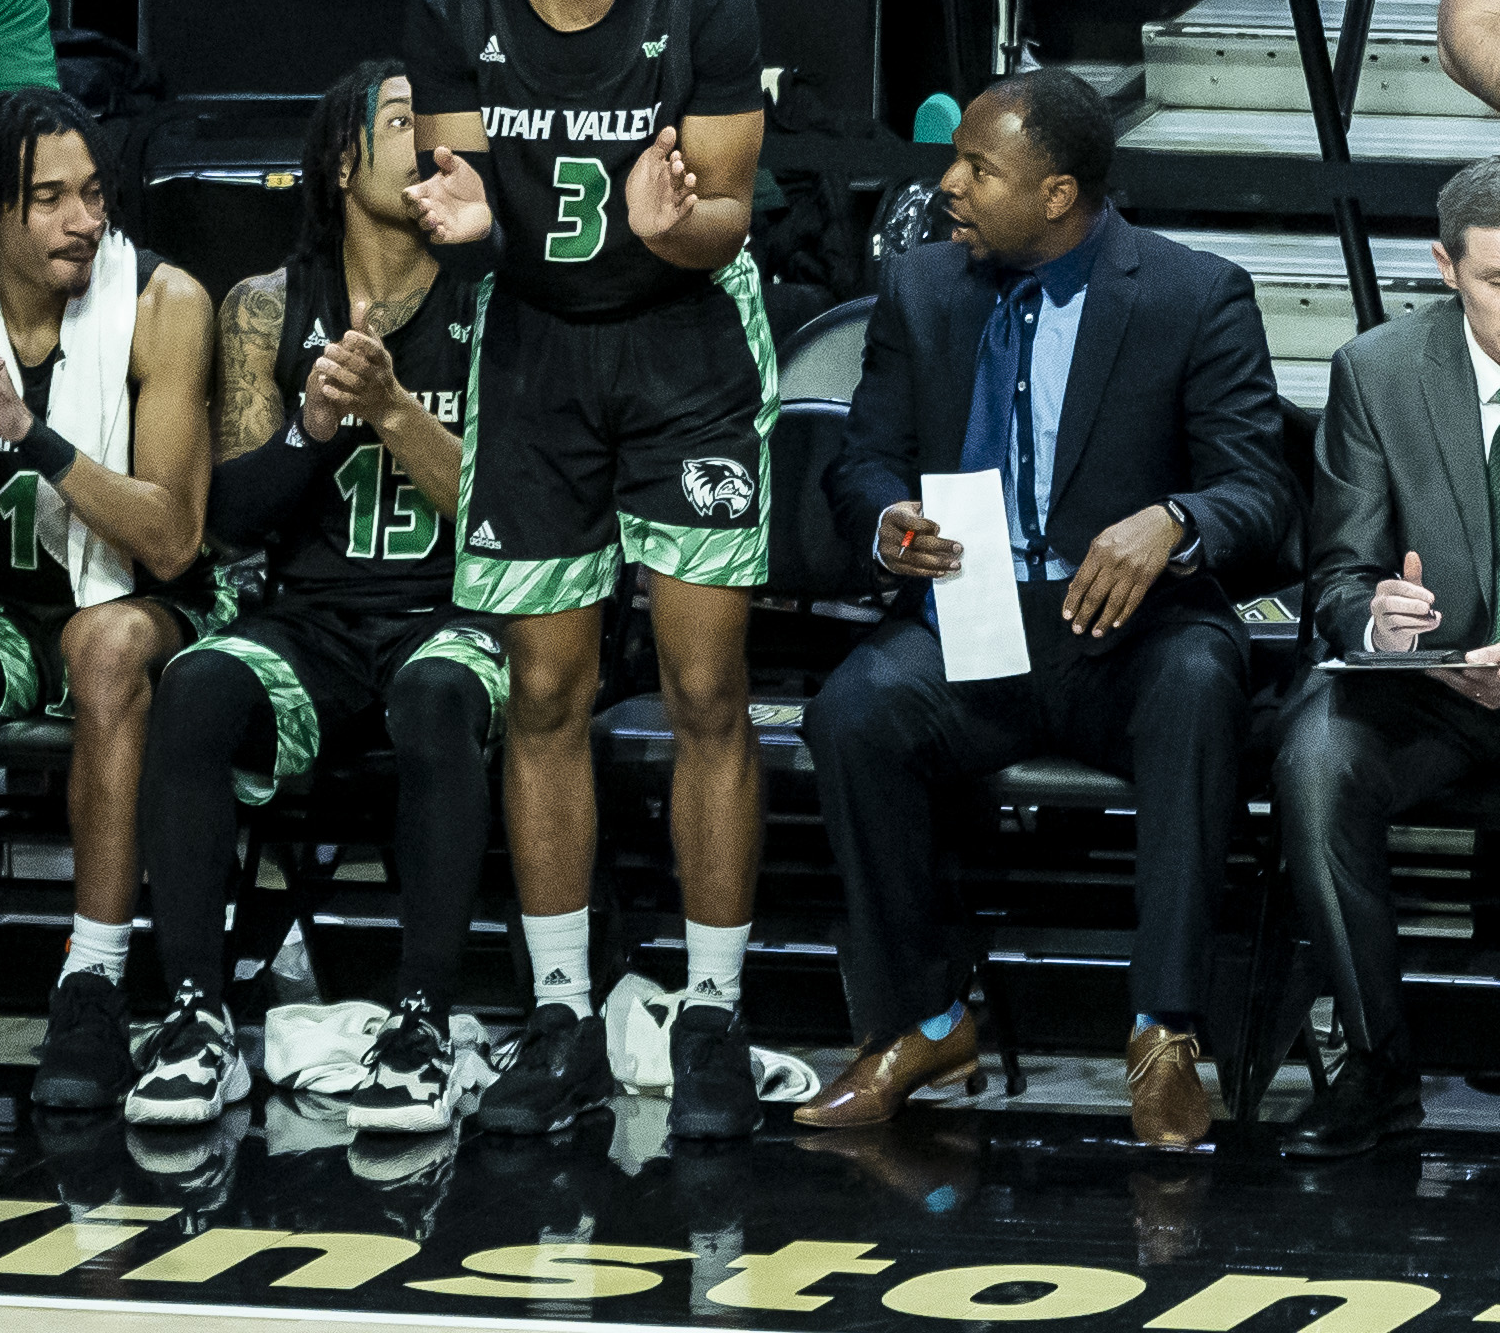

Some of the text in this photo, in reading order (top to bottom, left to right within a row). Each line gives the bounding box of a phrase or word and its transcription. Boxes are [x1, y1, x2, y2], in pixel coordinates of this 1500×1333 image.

[482, 103, 663, 142] UTAH VALLEY
[544, 157, 611, 262] 3
